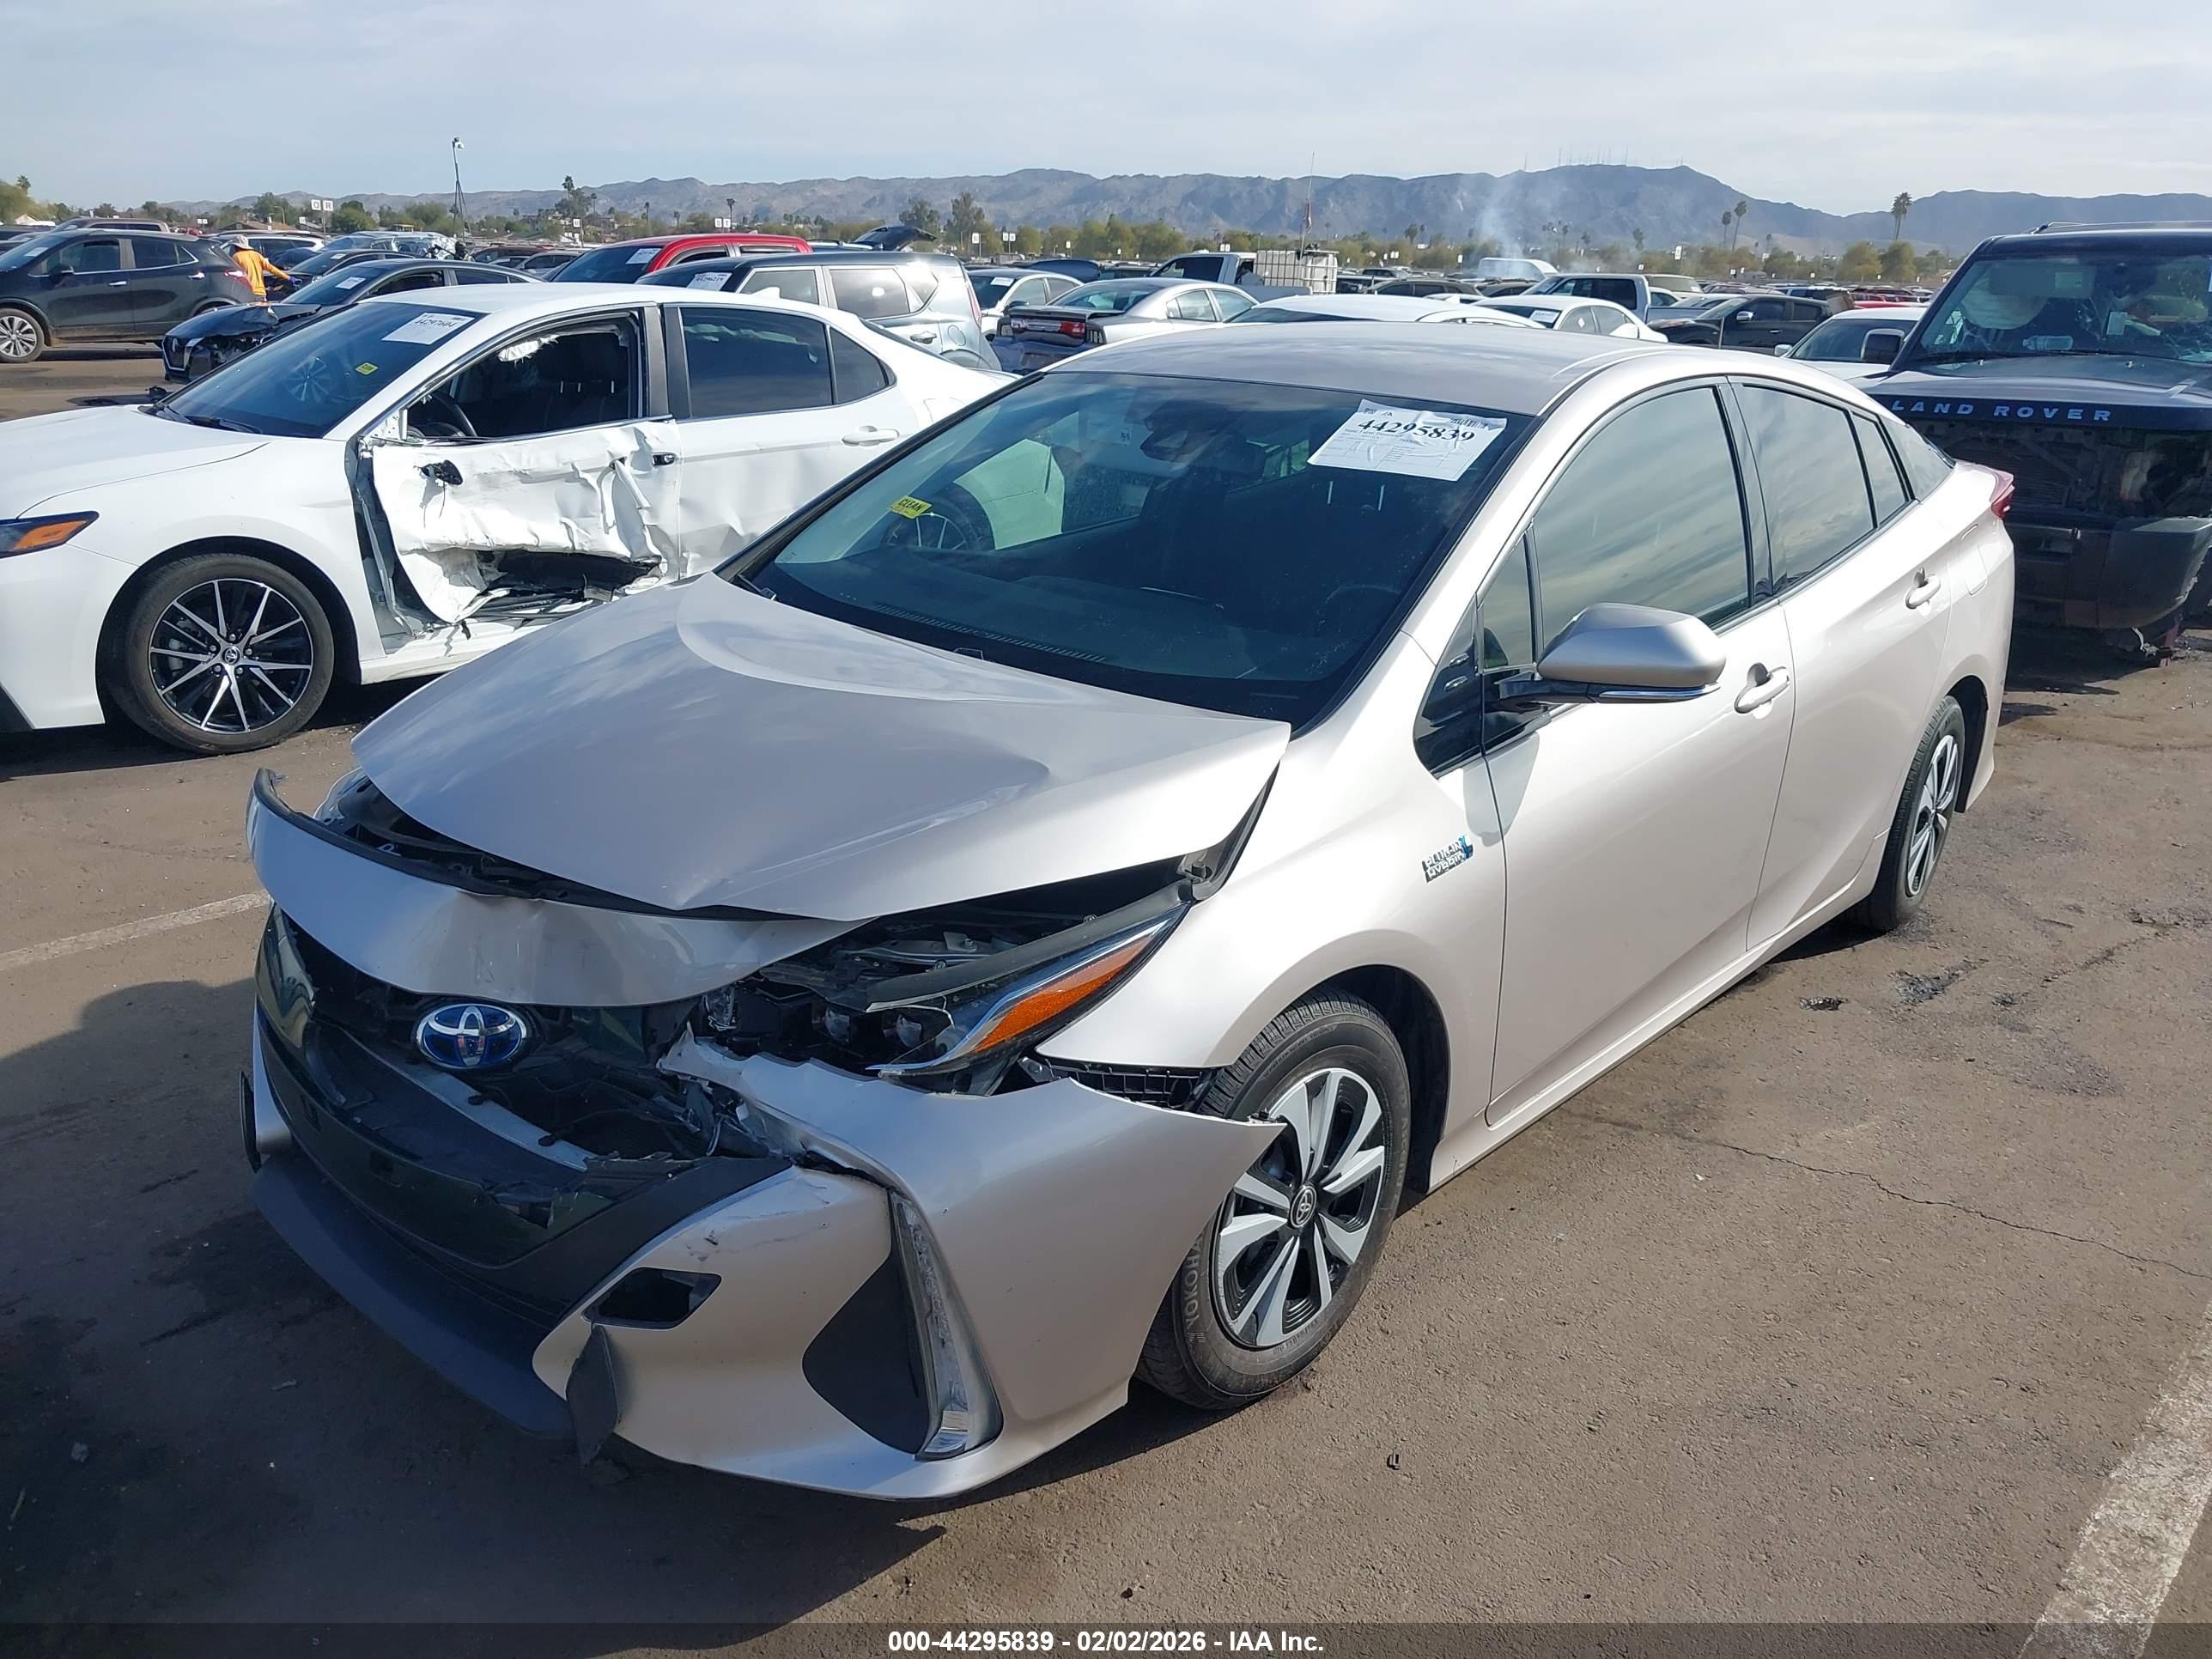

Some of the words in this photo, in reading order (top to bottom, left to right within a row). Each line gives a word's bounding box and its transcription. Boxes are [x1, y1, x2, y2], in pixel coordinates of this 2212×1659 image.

[1892, 400, 1973, 415] LAND
[1994, 405, 2112, 421] ROVER
[1358, 418, 1475, 441] 44295839
[898, 498, 925, 512] CLEAN
[1183, 1231, 1204, 1329] YOKOHA
